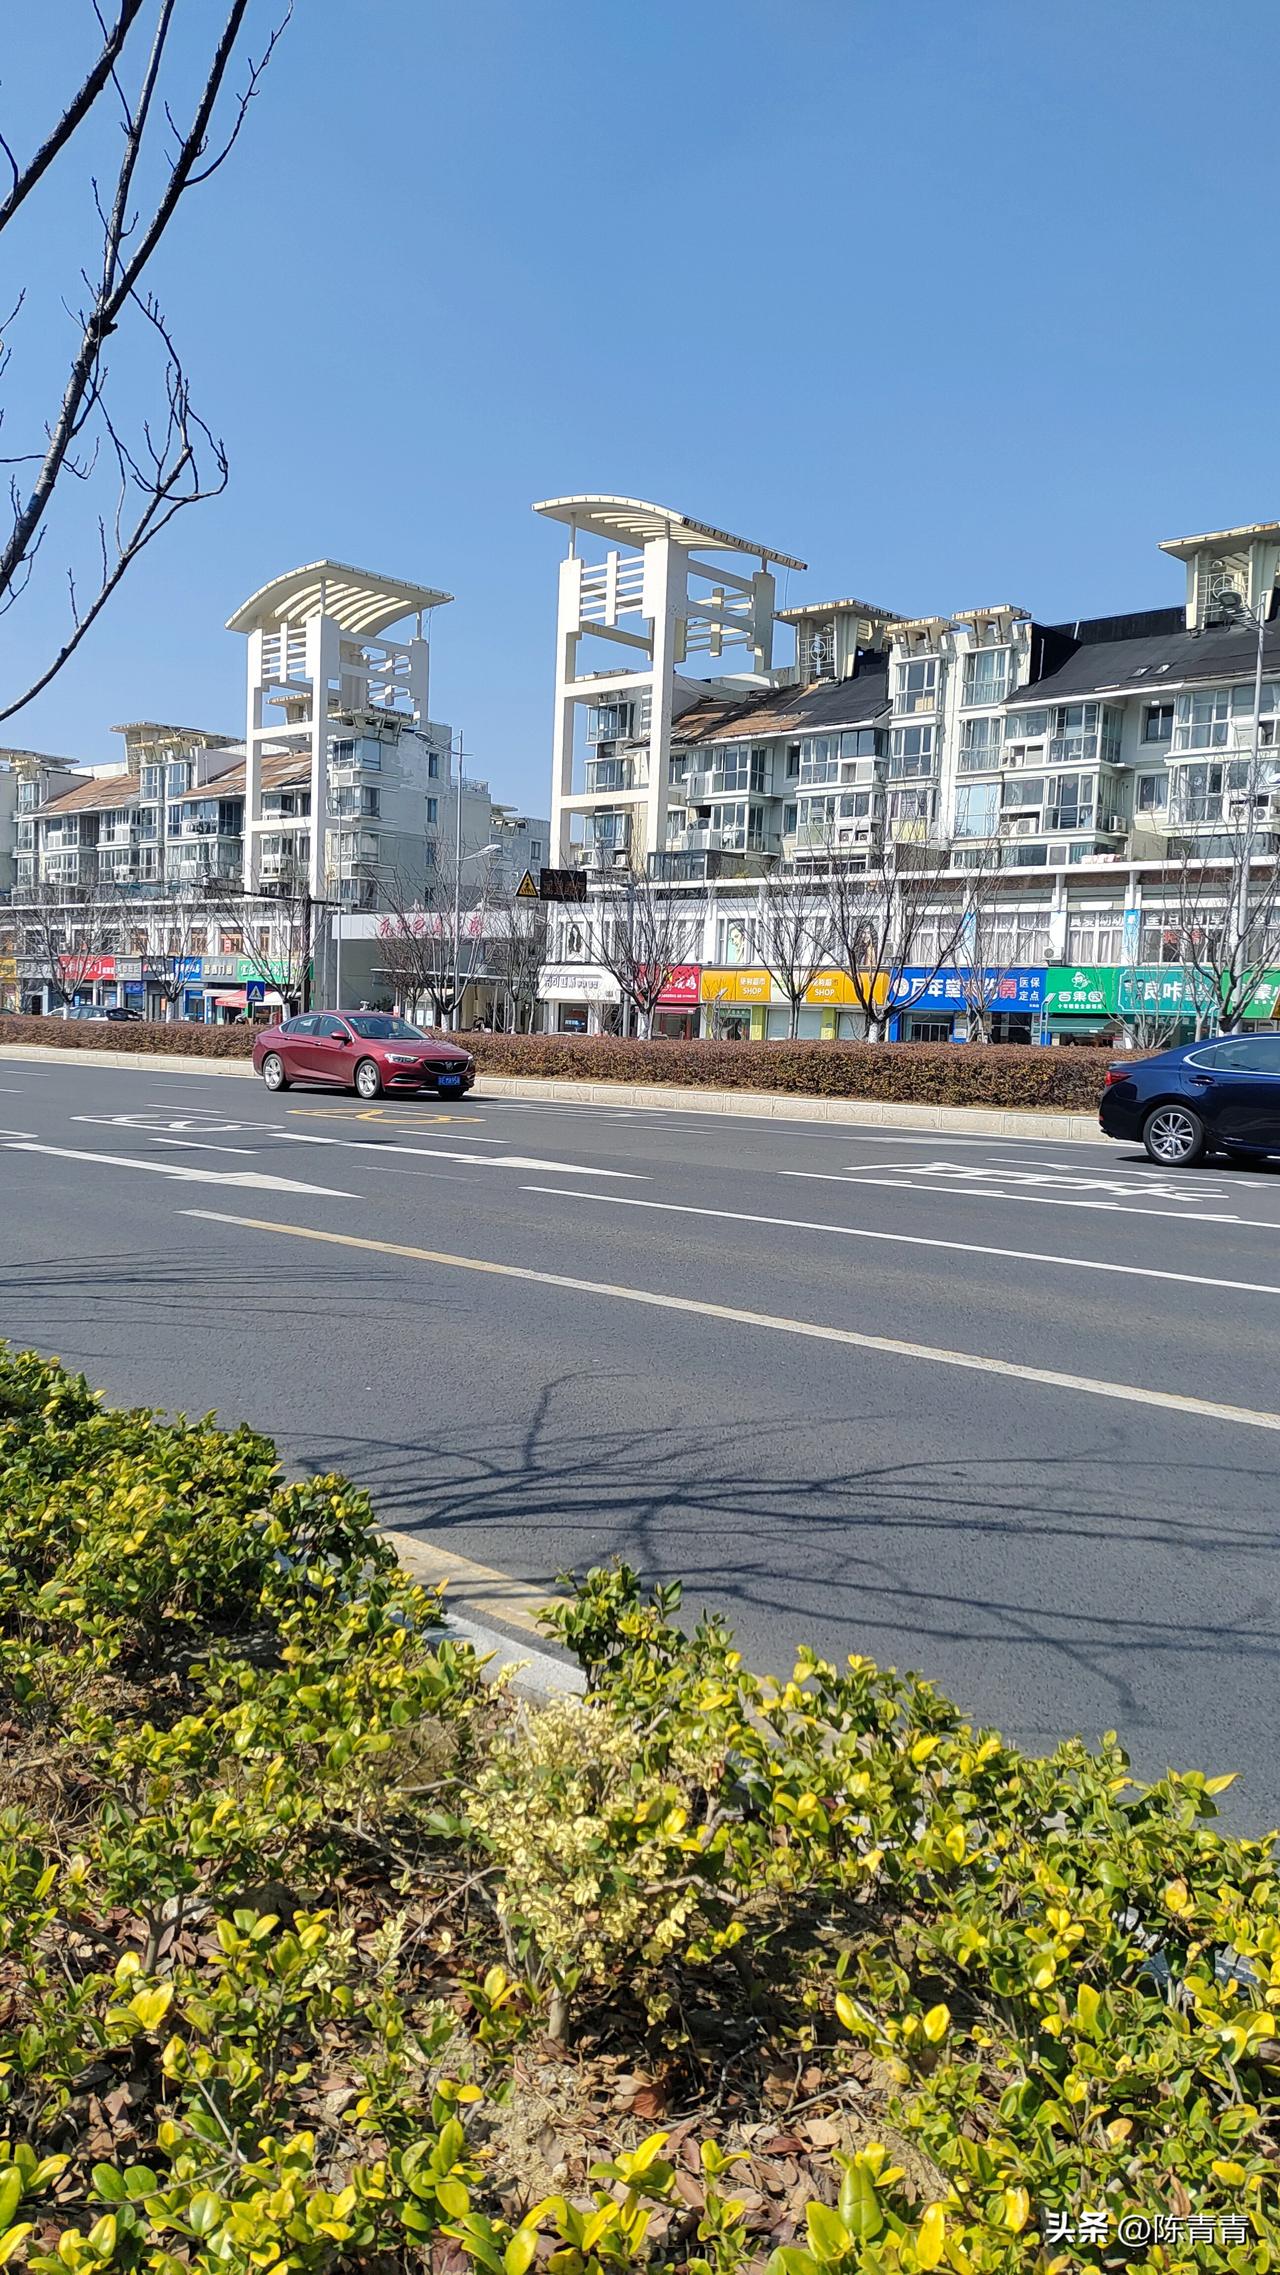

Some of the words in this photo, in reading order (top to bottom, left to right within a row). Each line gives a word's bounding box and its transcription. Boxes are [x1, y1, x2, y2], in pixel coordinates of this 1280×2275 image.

[1019, 976, 1041, 988] 医保
[743, 987, 762, 995] SHOP
[1018, 990, 1040, 1002] 定点
[1058, 991, 1103, 1002] 百果园
